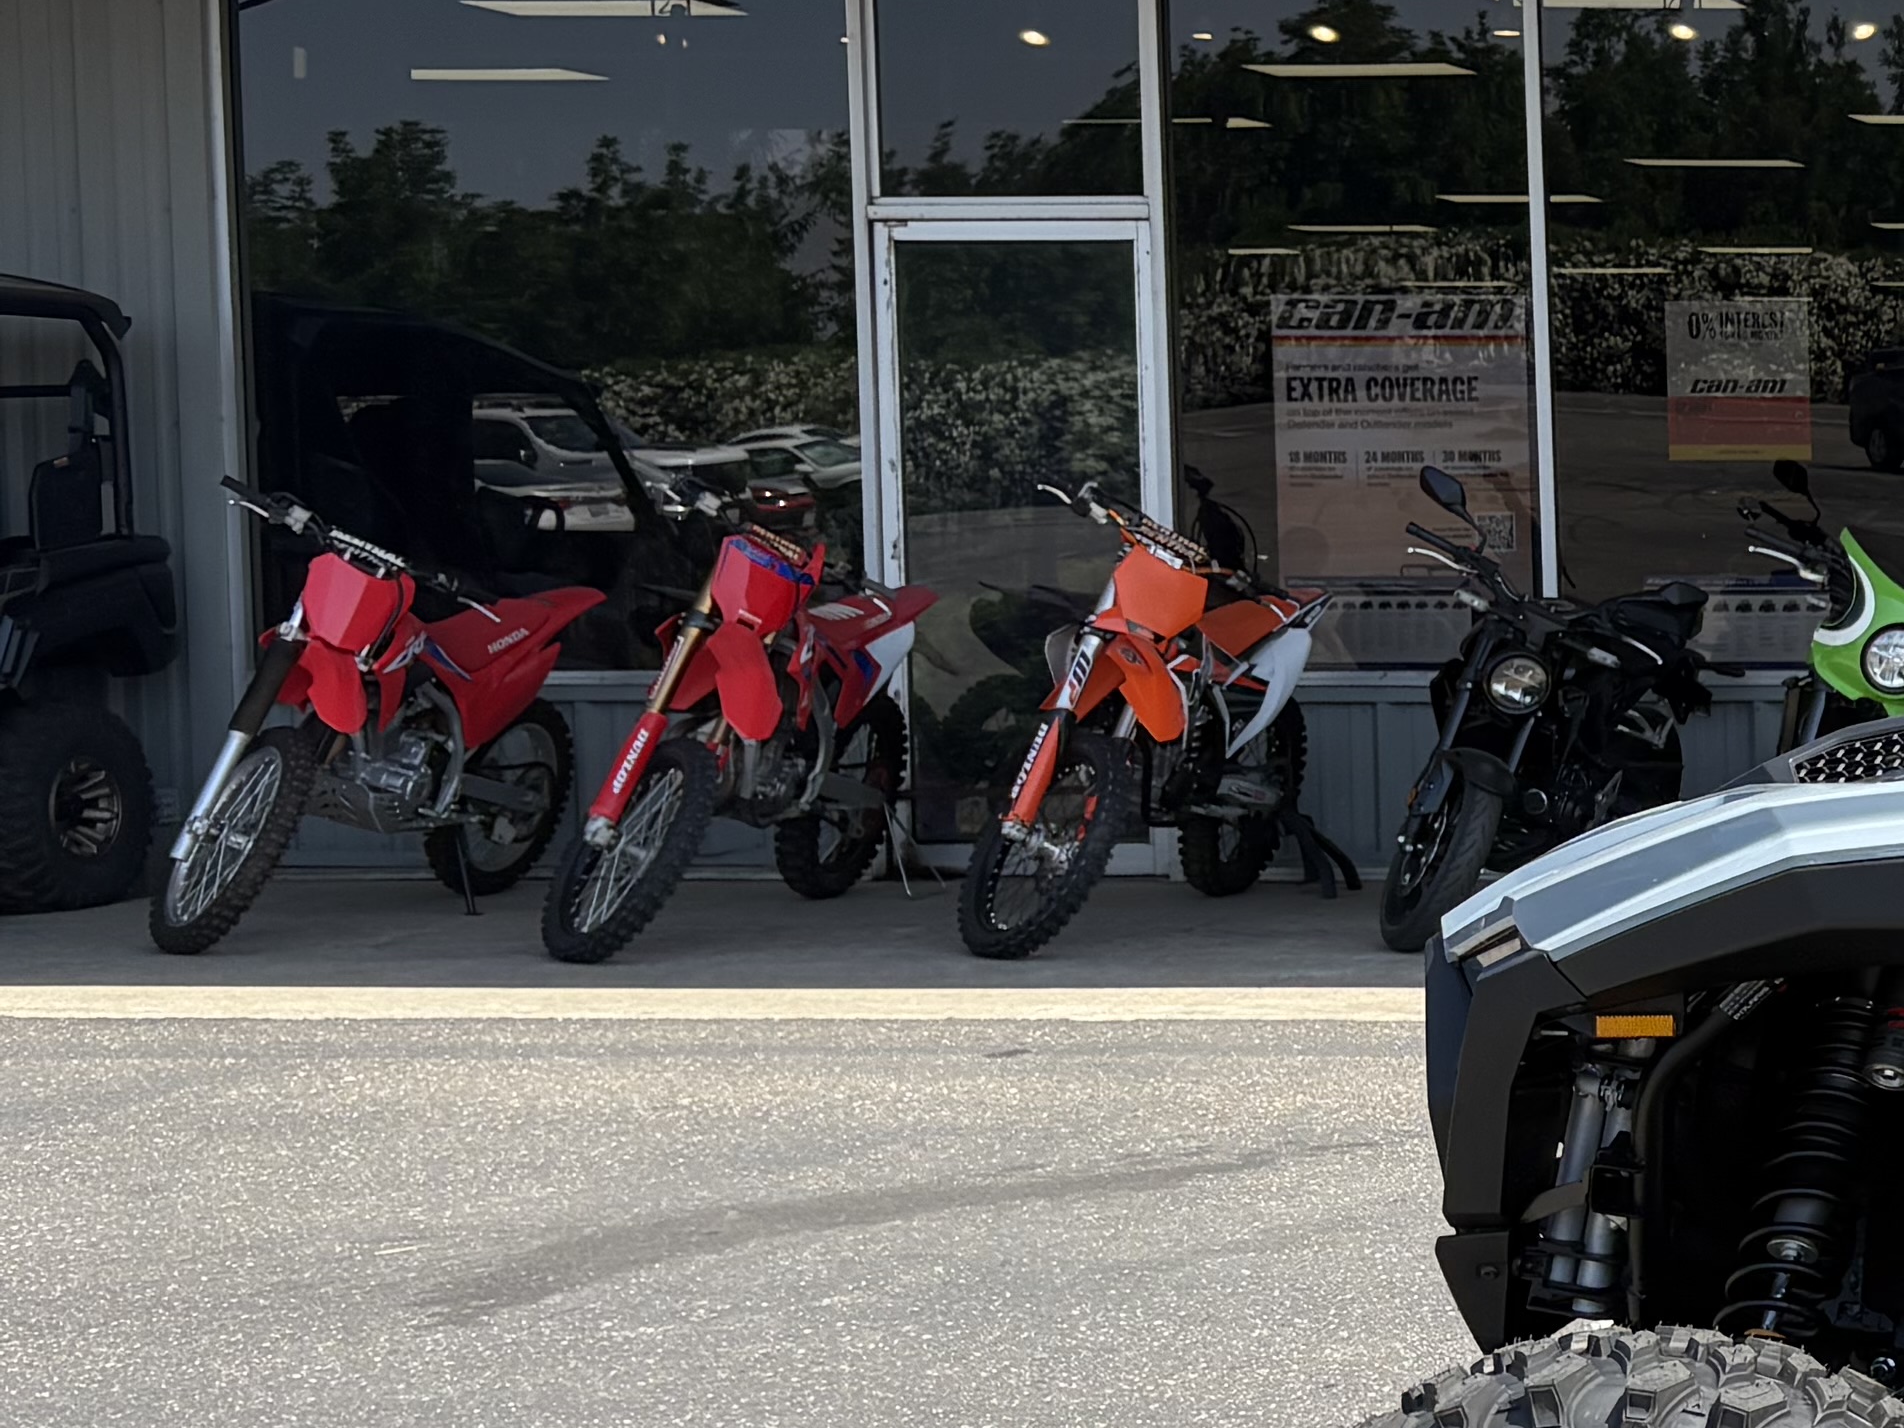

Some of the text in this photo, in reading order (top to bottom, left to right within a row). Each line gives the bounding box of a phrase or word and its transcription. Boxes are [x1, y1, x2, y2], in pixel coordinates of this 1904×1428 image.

[1275, 298, 1517, 331] can-am
[1687, 312, 1716, 341] 0%
[1719, 310, 1786, 330] INTEREST
[1286, 375, 1480, 403] EXTRA COVERAGE
[1690, 378, 1787, 394] can-am
[1302, 450, 1348, 464] MONTHS
[1364, 450, 1425, 464] 24 MONTHS
[486, 627, 530, 655] HONDA
[612, 728, 649, 794] DUNLOP
